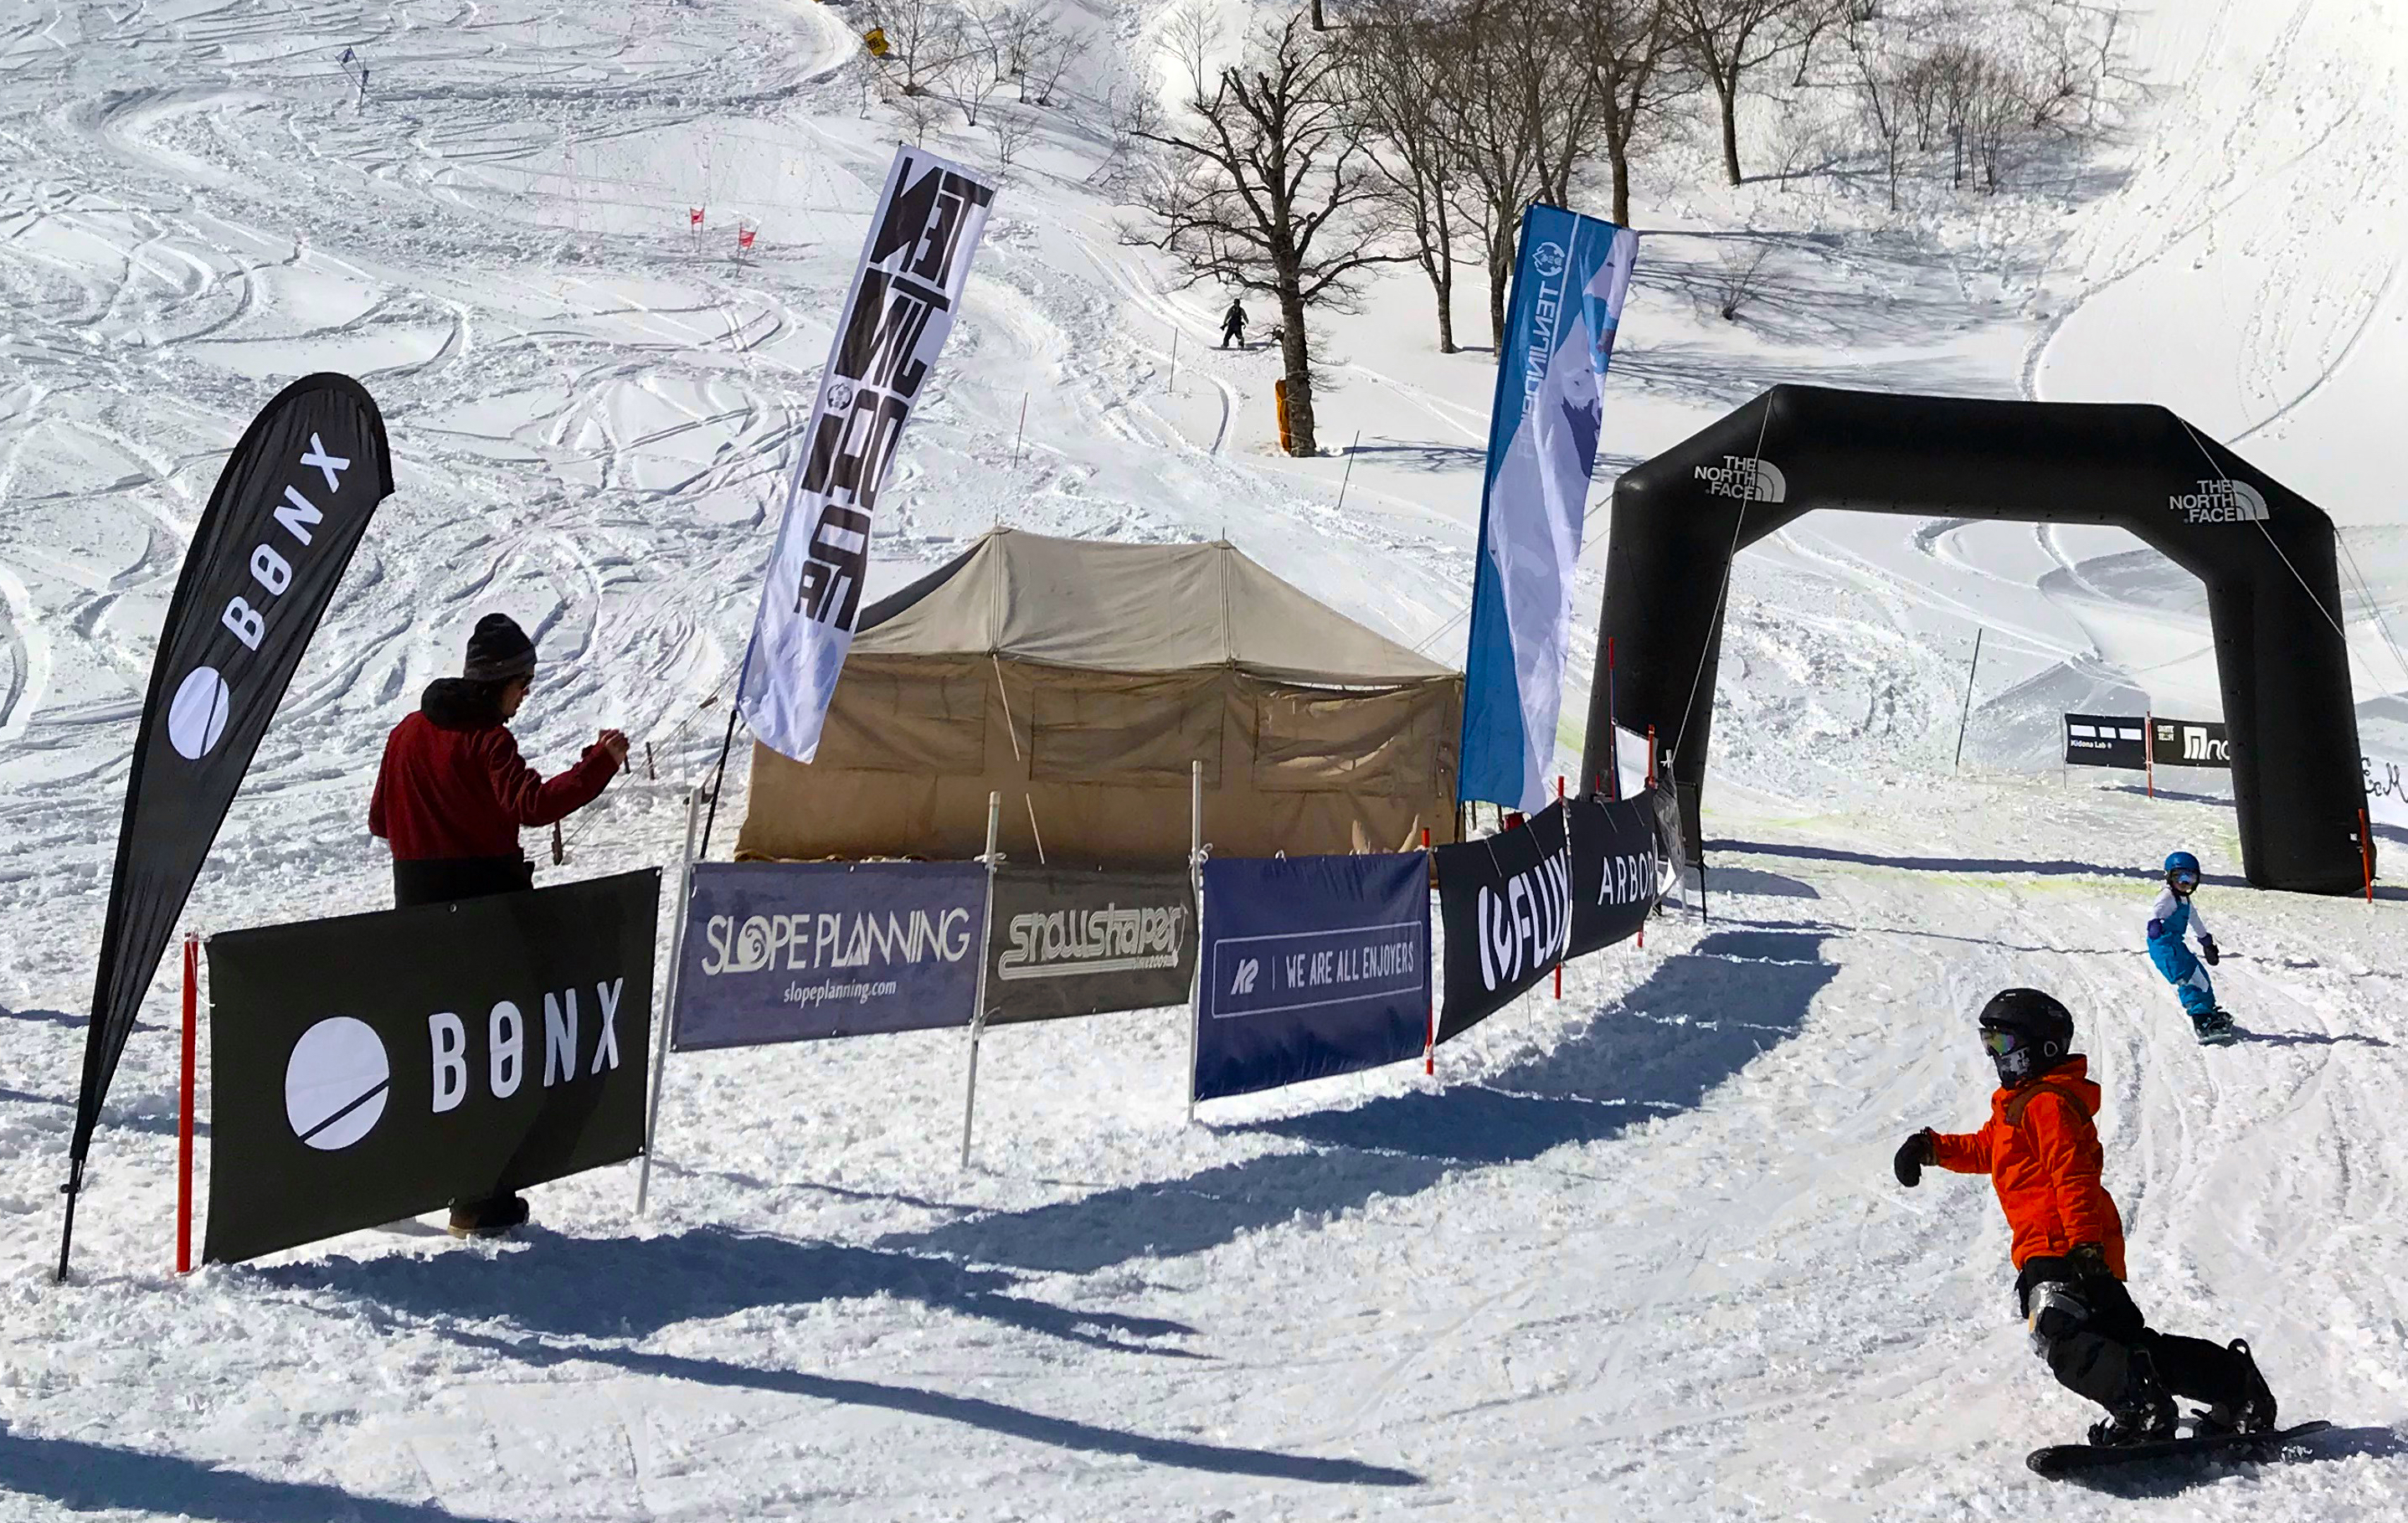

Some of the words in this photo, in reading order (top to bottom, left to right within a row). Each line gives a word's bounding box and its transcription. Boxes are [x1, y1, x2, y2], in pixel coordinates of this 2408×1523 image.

[1723, 455, 1757, 471] THE
[1694, 466, 1757, 486] NORTH
[1711, 481, 1755, 501] FACE
[2196, 479, 2234, 494] THE
[2169, 493, 2235, 510] NORTH
[2189, 507, 2236, 523] FACE
[1598, 851, 1654, 906] ARBOR
[702, 913, 811, 976] SLOPE
[813, 907, 970, 969] PLANNING
[1285, 953, 1306, 989] WE
[1309, 950, 1333, 986] ARE
[1336, 948, 1360, 983] ALL
[1362, 941, 1415, 980] ENJOYERS
[783, 978, 897, 1009] slopeplanning.com
